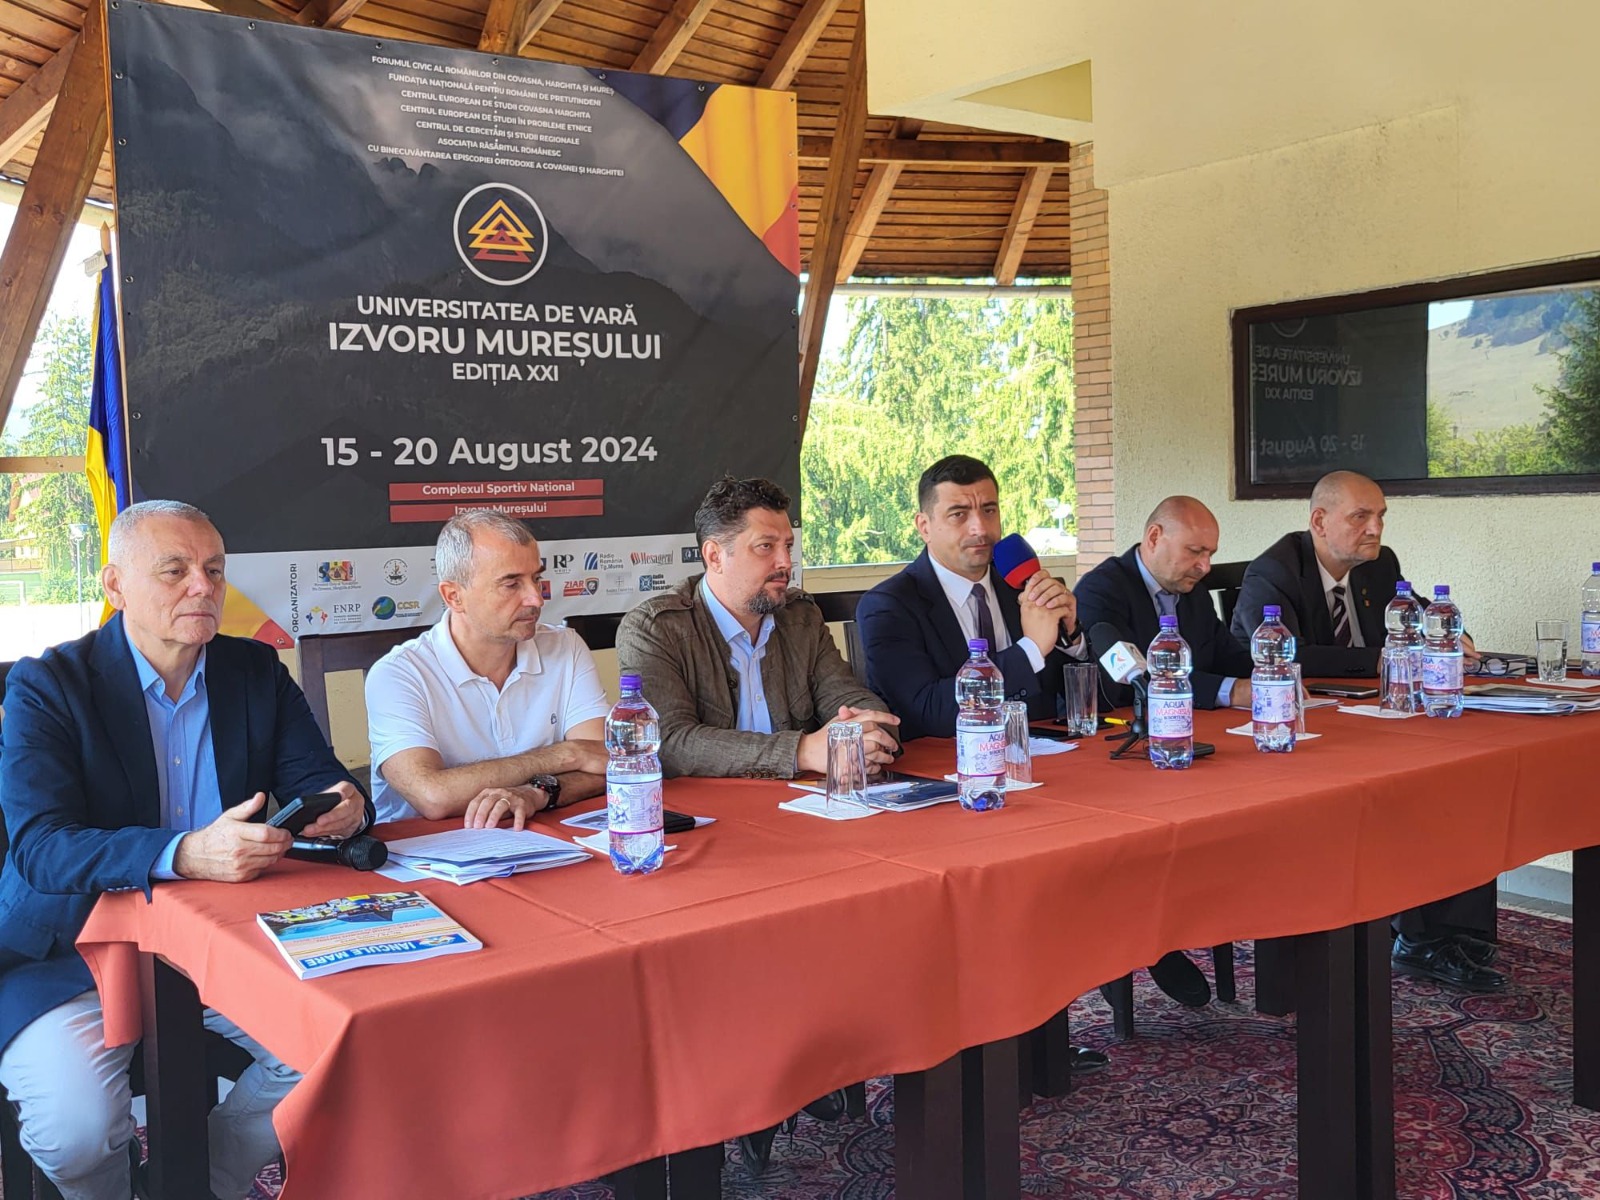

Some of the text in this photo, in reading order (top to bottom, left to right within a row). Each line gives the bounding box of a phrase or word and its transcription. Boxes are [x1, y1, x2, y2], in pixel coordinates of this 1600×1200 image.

[372, 55, 411, 68] FORUMUL
[412, 61, 432, 71] CIVIC
[433, 65, 444, 73] AL
[445, 66, 491, 78] ROMÂNILOR
[493, 72, 506, 80] DIN
[507, 73, 545, 86] COVASNA,
[546, 80, 582, 90] HARGHITA
[590, 86, 615, 96] MUREȘ
[388, 73, 428, 86] FUNDAȚIA
[429, 79, 474, 91] NAȚIONALĂ
[474, 84, 505, 94] PENTRU
[506, 88, 538, 98] ROMÂNII
[550, 94, 602, 106] PRETUTINDENI
[400, 104, 437, 115] CENTRUL
[438, 108, 480, 120] EUROPEAN
[493, 115, 516, 124] STUDII
[518, 116, 526, 126] ÎN
[527, 120, 566, 131] PROBLEME
[567, 124, 592, 133] ETNICE
[401, 90, 438, 101] CENTRUL
[438, 94, 480, 106] EUROPEAN
[494, 101, 518, 110] STUDII
[518, 104, 554, 115] COVASNA
[555, 108, 591, 119] HARGHITA
[416, 121, 452, 132] CENTRUL
[464, 126, 506, 137] CERCETĂRI
[514, 132, 538, 140] STUDII
[540, 134, 580, 145] REGIONALE
[368, 144, 380, 152] CU
[380, 146, 452, 160] BINECUVÂNTAREA
[452, 153, 494, 164] EPISCOPIEI
[494, 158, 535, 168] ORTODOXE
[543, 162, 578, 173] COVASNEI
[586, 167, 624, 177] HARGHITEI
[438, 138, 478, 149] ASOCIAȚIA
[520, 146, 562, 157] ROMÂNESC
[357, 295, 638, 326] UNIVERSITATEA DE VARĂ
[328, 322, 661, 366] IZVORU MUREȘULUI
[452, 362, 560, 387] EDIȚIA XXI
[320, 437, 360, 466] 15
[392, 436, 438, 466] 20
[448, 436, 573, 471] August
[580, 436, 658, 463] 2024
[422, 482, 575, 497] Complexul Sportiv Național
[493, 502, 548, 516] Mureșului
[290, 563, 299, 632] ORGANIZATORI
[564, 580, 584, 588] ZIAR
[333, 603, 361, 614] FNRP
[397, 600, 420, 610] CCSR
[304, 940, 417, 967] IANCULE MARE
